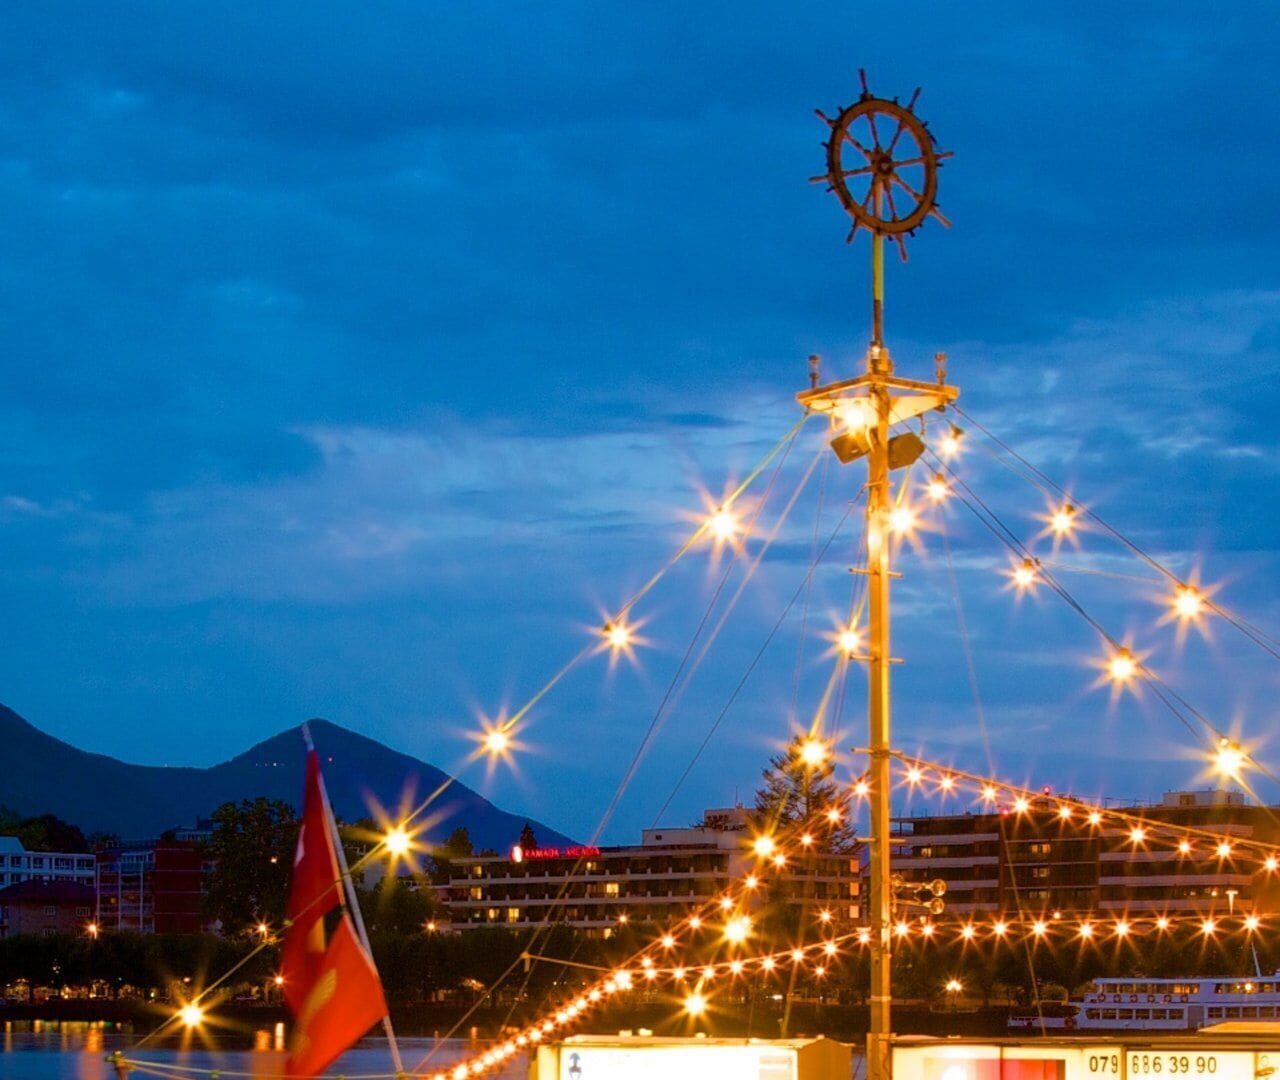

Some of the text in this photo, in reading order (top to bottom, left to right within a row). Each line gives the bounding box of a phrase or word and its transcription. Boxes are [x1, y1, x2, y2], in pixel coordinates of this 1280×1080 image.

[1089, 1055, 1118, 1073] 079
[1169, 1056, 1189, 1073] 39
[1196, 1056, 1217, 1073] 90
